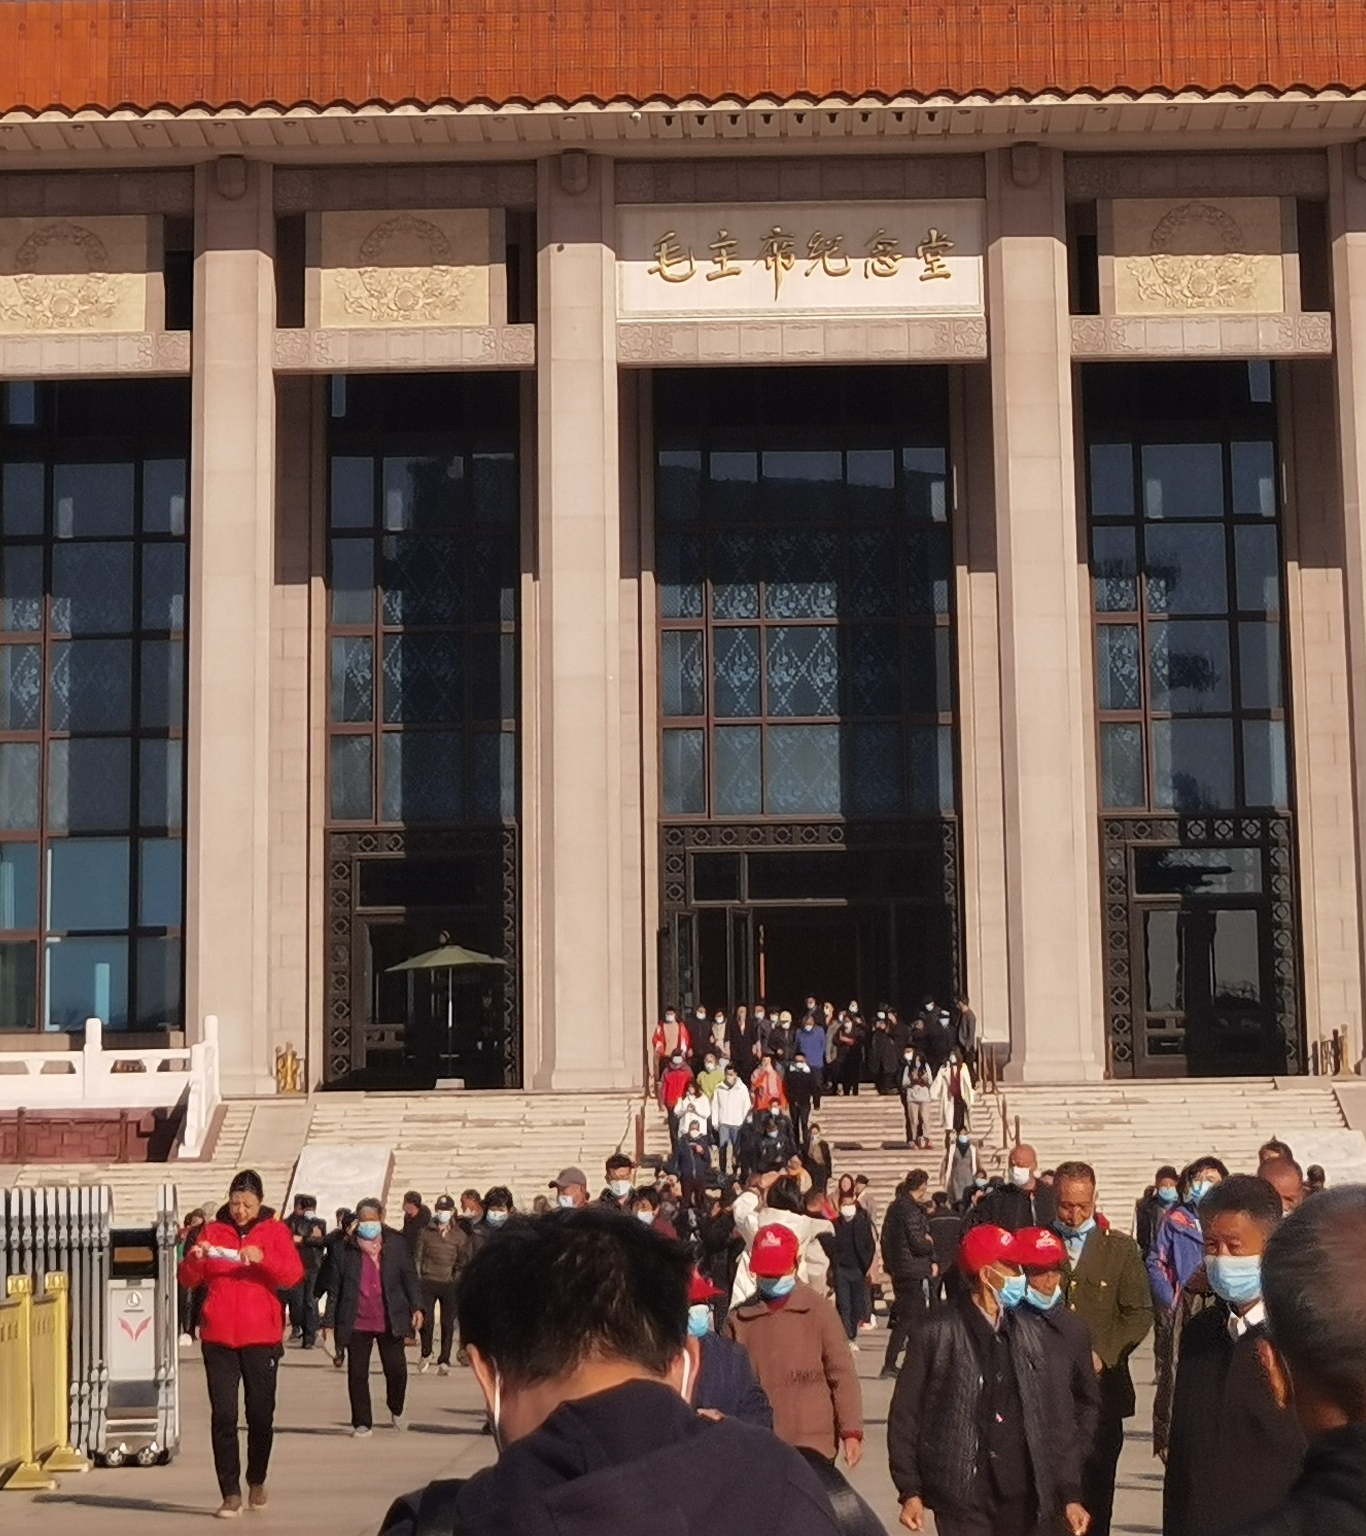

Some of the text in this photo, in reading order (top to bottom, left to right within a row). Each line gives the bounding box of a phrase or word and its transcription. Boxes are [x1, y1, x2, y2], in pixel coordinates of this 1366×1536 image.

[647, 225, 956, 301] 毛主席纪念堂
